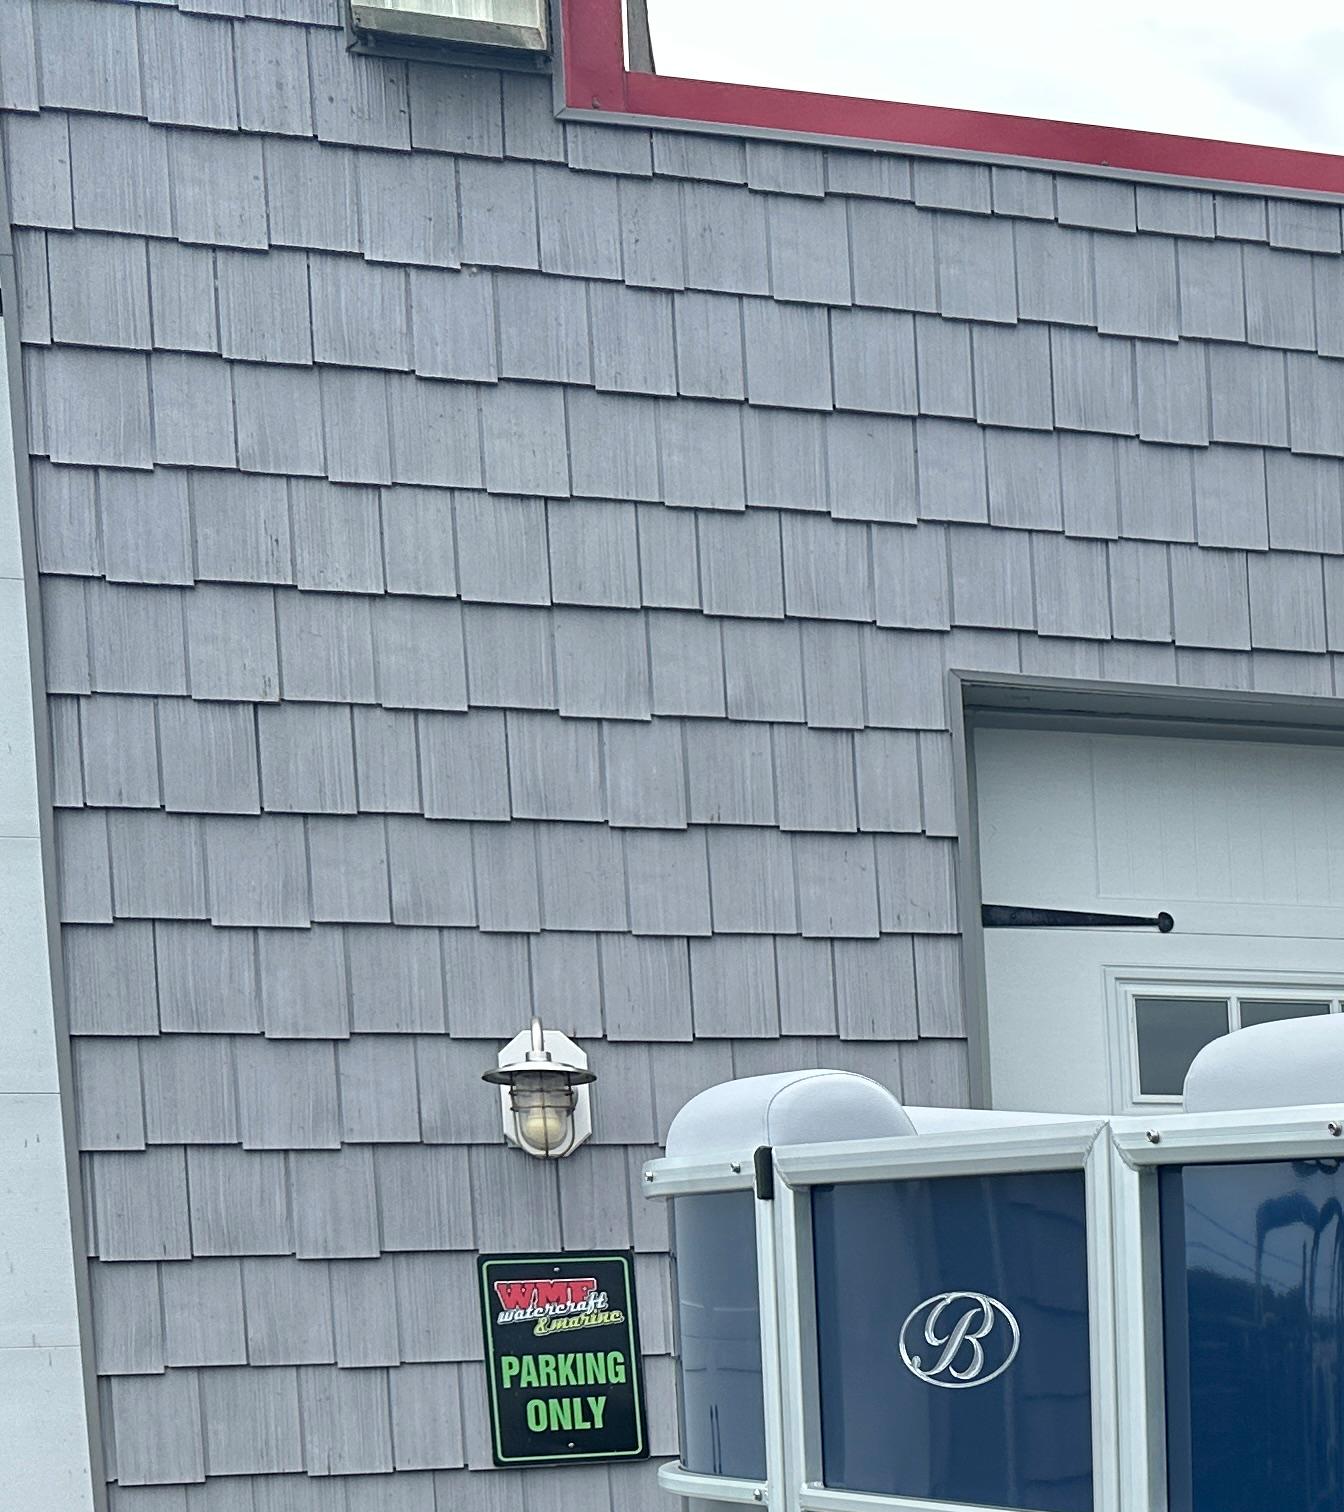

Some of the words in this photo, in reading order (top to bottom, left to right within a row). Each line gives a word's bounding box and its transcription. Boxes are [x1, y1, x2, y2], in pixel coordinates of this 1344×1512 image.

[912, 1291, 995, 1380] B
[501, 1351, 627, 1389] PARKING
[526, 1396, 607, 1433] ONLY
